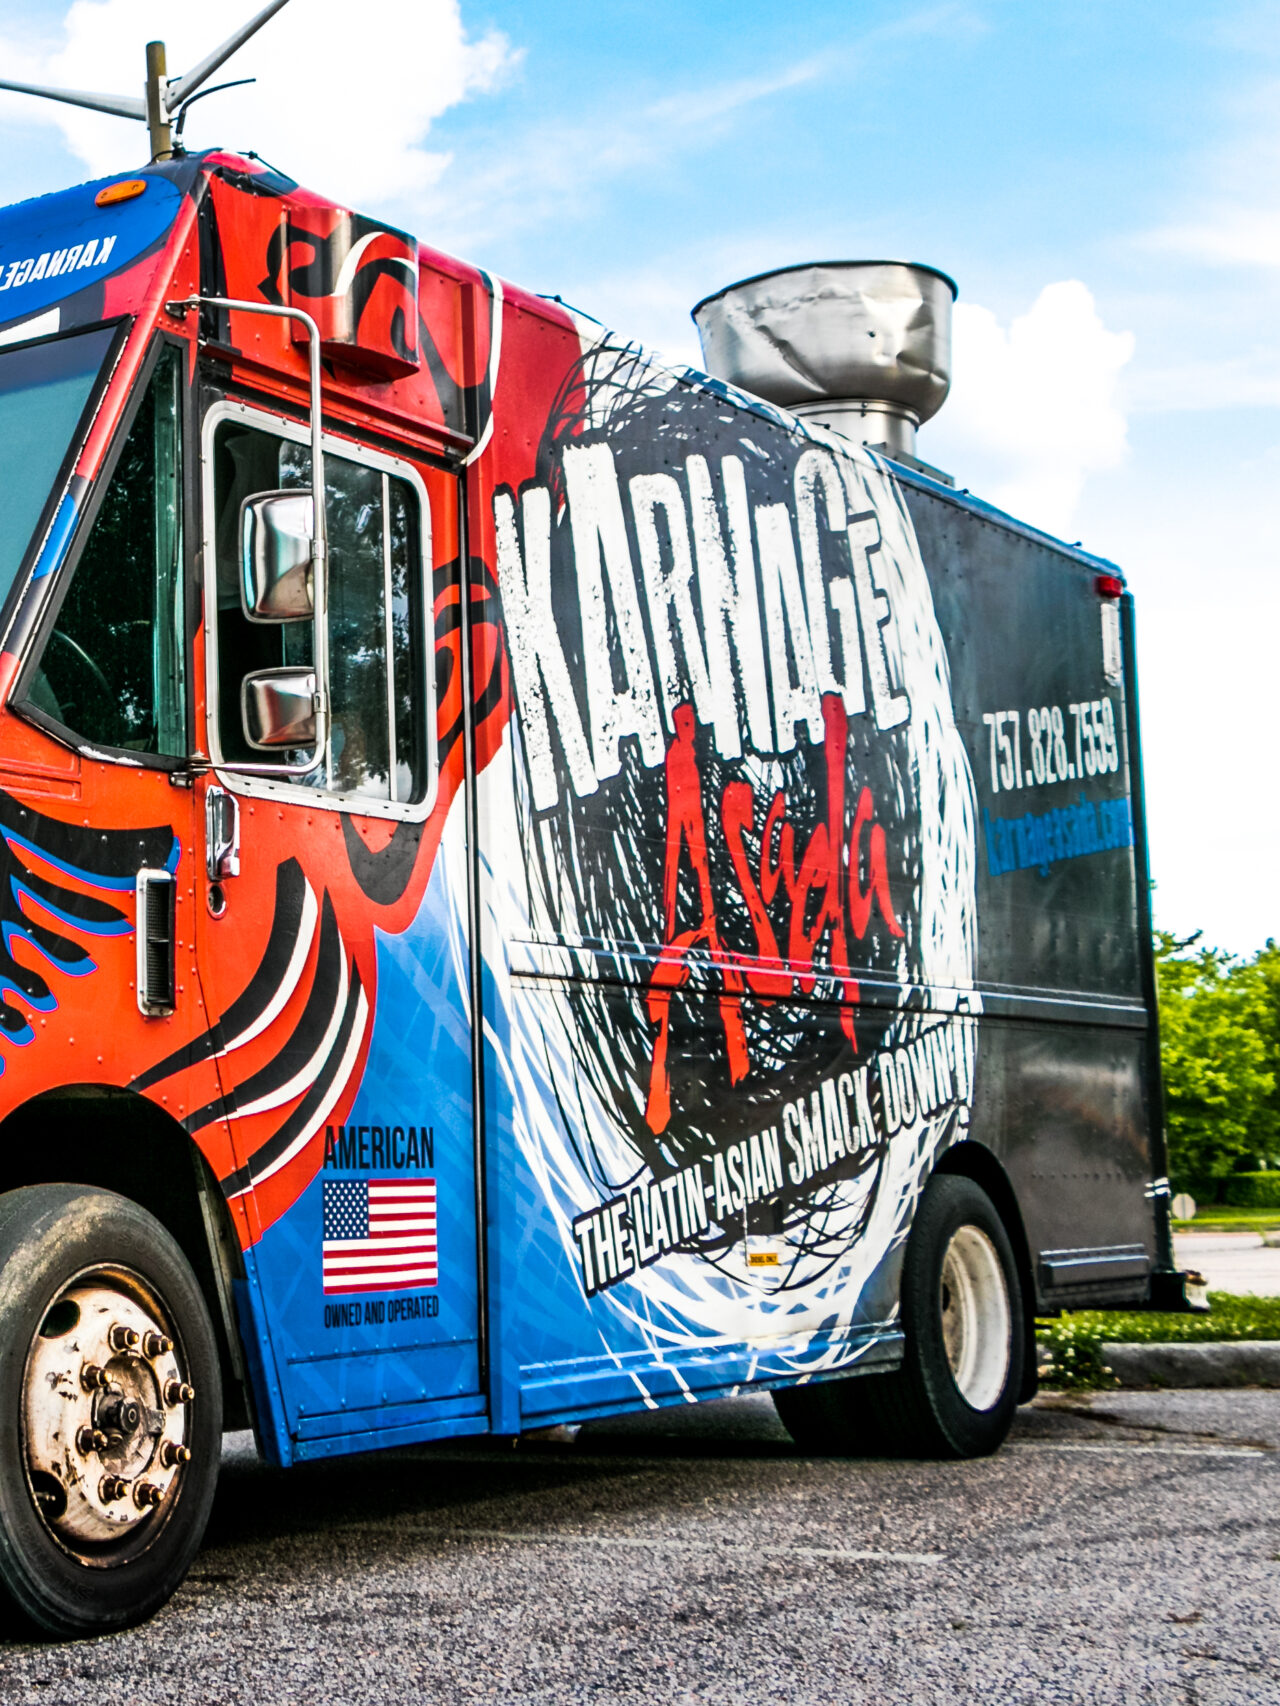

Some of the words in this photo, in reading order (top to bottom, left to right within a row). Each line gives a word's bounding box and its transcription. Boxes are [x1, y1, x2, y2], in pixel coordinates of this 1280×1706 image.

[494, 442, 911, 812] KARNAGE
[983, 697, 1118, 793] 757.828.7559
[323, 1125, 434, 1170] AMERICAN
[574, 1201, 635, 1291] THE
[633, 1126, 784, 1262] LATIN-ASIAN
[783, 1065, 877, 1184] SMACK
[324, 1302, 361, 1328] OWNED
[364, 1300, 385, 1325] AND
[387, 1295, 439, 1323] OPERATED
